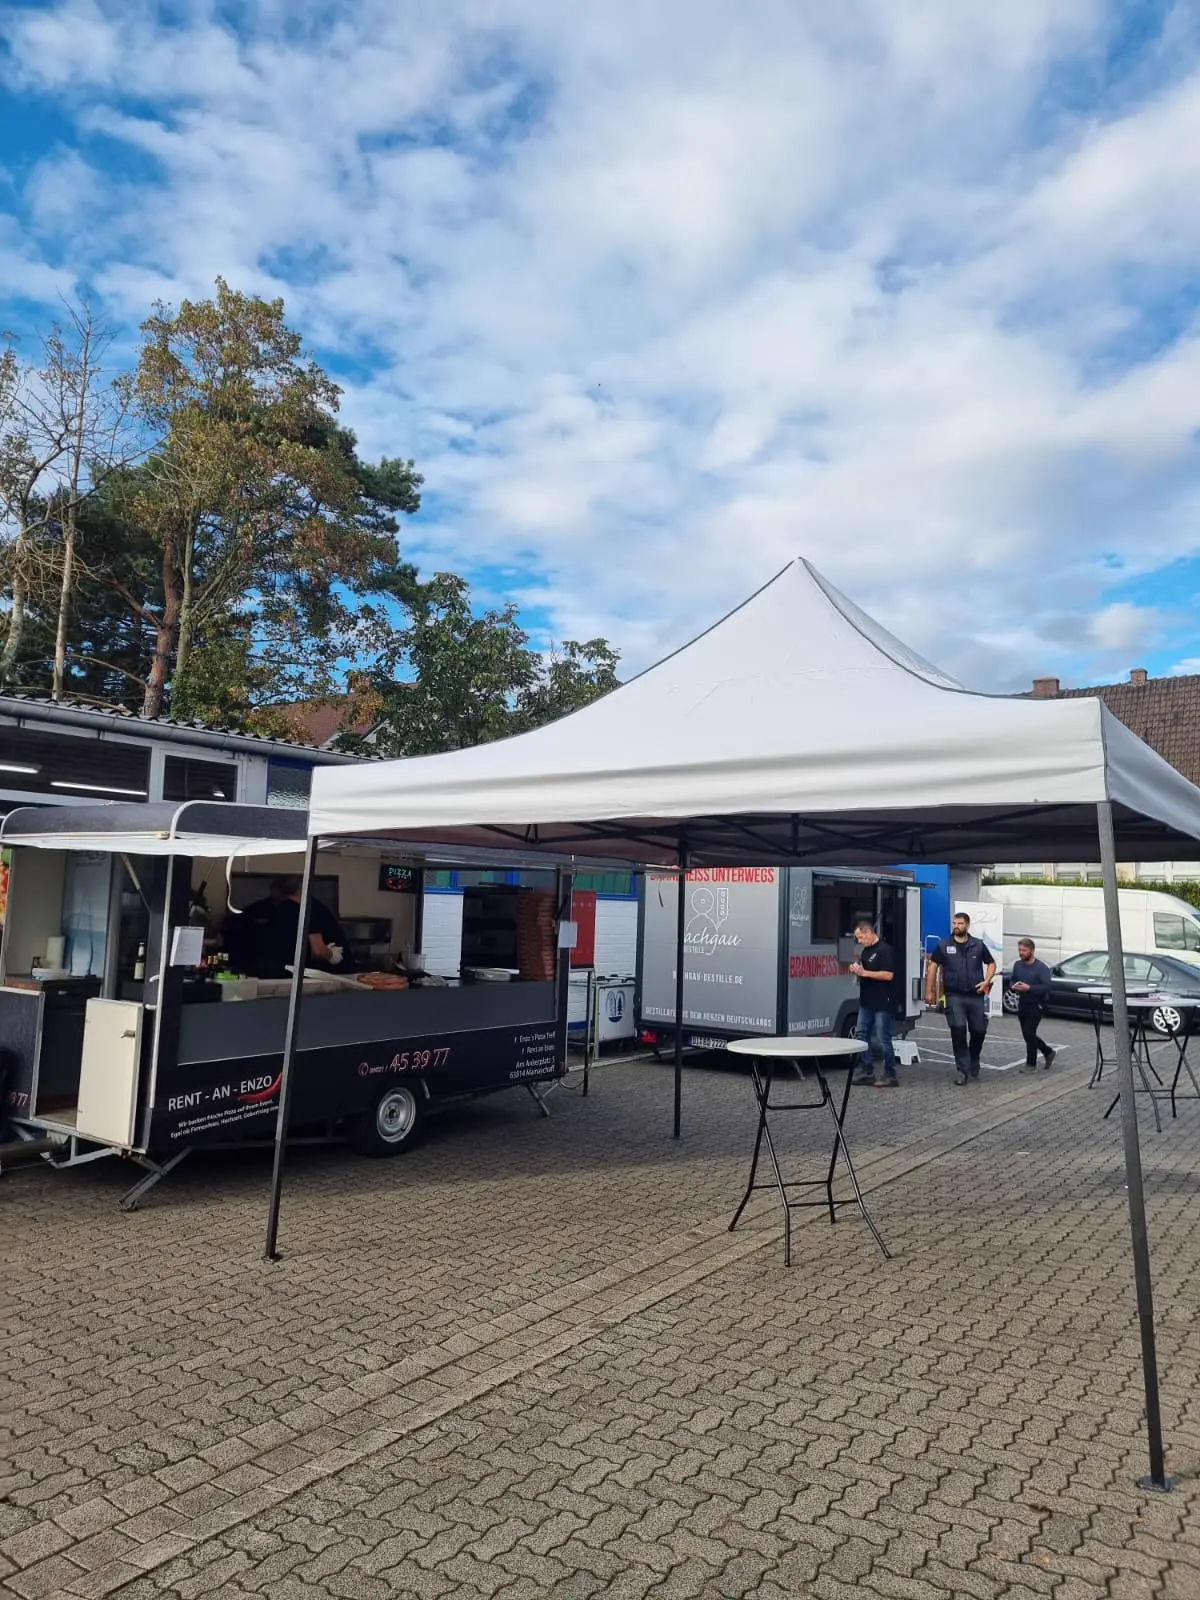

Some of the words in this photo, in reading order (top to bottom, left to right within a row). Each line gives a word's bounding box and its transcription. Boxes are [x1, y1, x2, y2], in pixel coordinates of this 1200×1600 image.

[388, 867, 412, 877] PIZZA
[711, 867, 775, 883] UNTERWEGS
[683, 926, 741, 956] achgau
[790, 955, 838, 979] BRANDHEISS
[390, 1052, 410, 1072] 45
[411, 1049, 431, 1070] 39
[432, 1047, 451, 1068] 77
[168, 1091, 203, 1112] RENT
[211, 1084, 231, 1101] AN
[240, 1075, 273, 1094] ENZO
